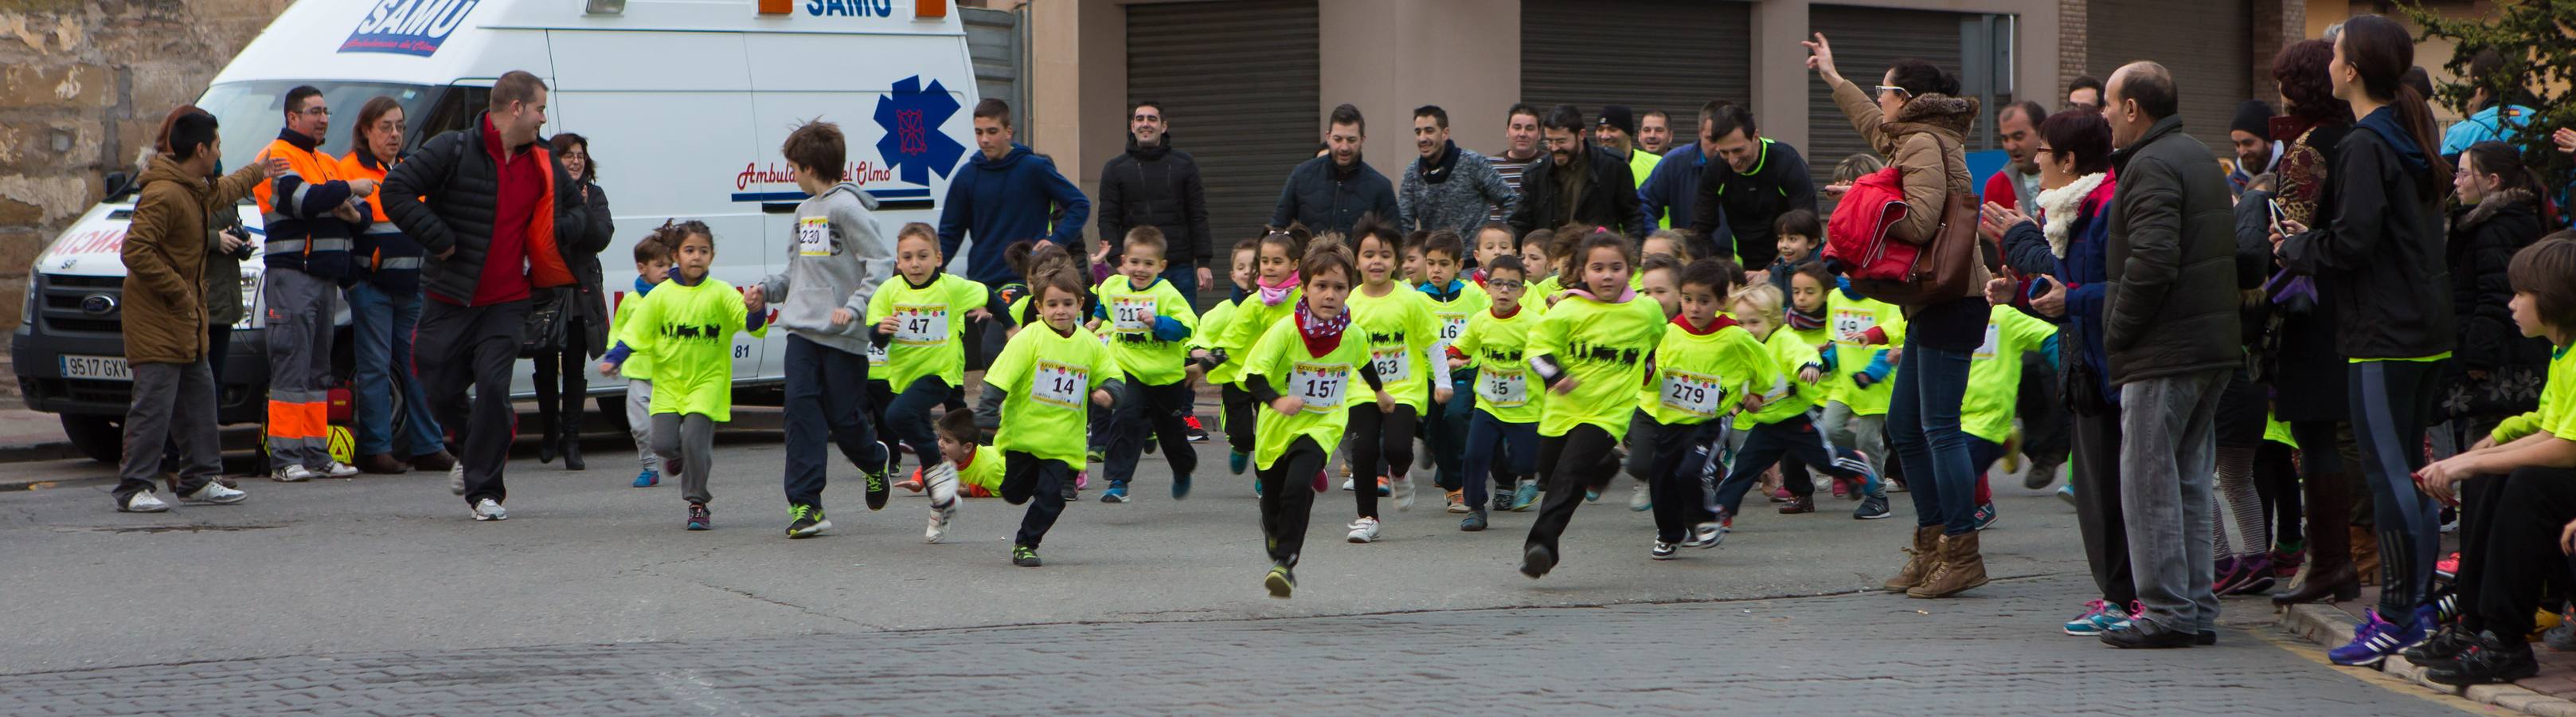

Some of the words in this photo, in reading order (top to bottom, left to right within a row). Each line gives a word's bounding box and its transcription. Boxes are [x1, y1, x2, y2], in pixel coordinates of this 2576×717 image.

[806, 0, 892, 18] SAMU
[358, 0, 475, 38] SAMU
[737, 162, 797, 190] Ambula
[841, 161, 853, 182] el
[856, 161, 890, 186] Olmo
[799, 229, 819, 244] 230
[1120, 308, 1143, 322] 21
[909, 319, 930, 334] 47
[734, 345, 749, 358] 81
[70, 358, 100, 376] 9517
[104, 360, 127, 377] GXV
[1053, 377, 1074, 394] 14
[1305, 379, 1338, 398] 157
[1672, 383, 1704, 404] 279
